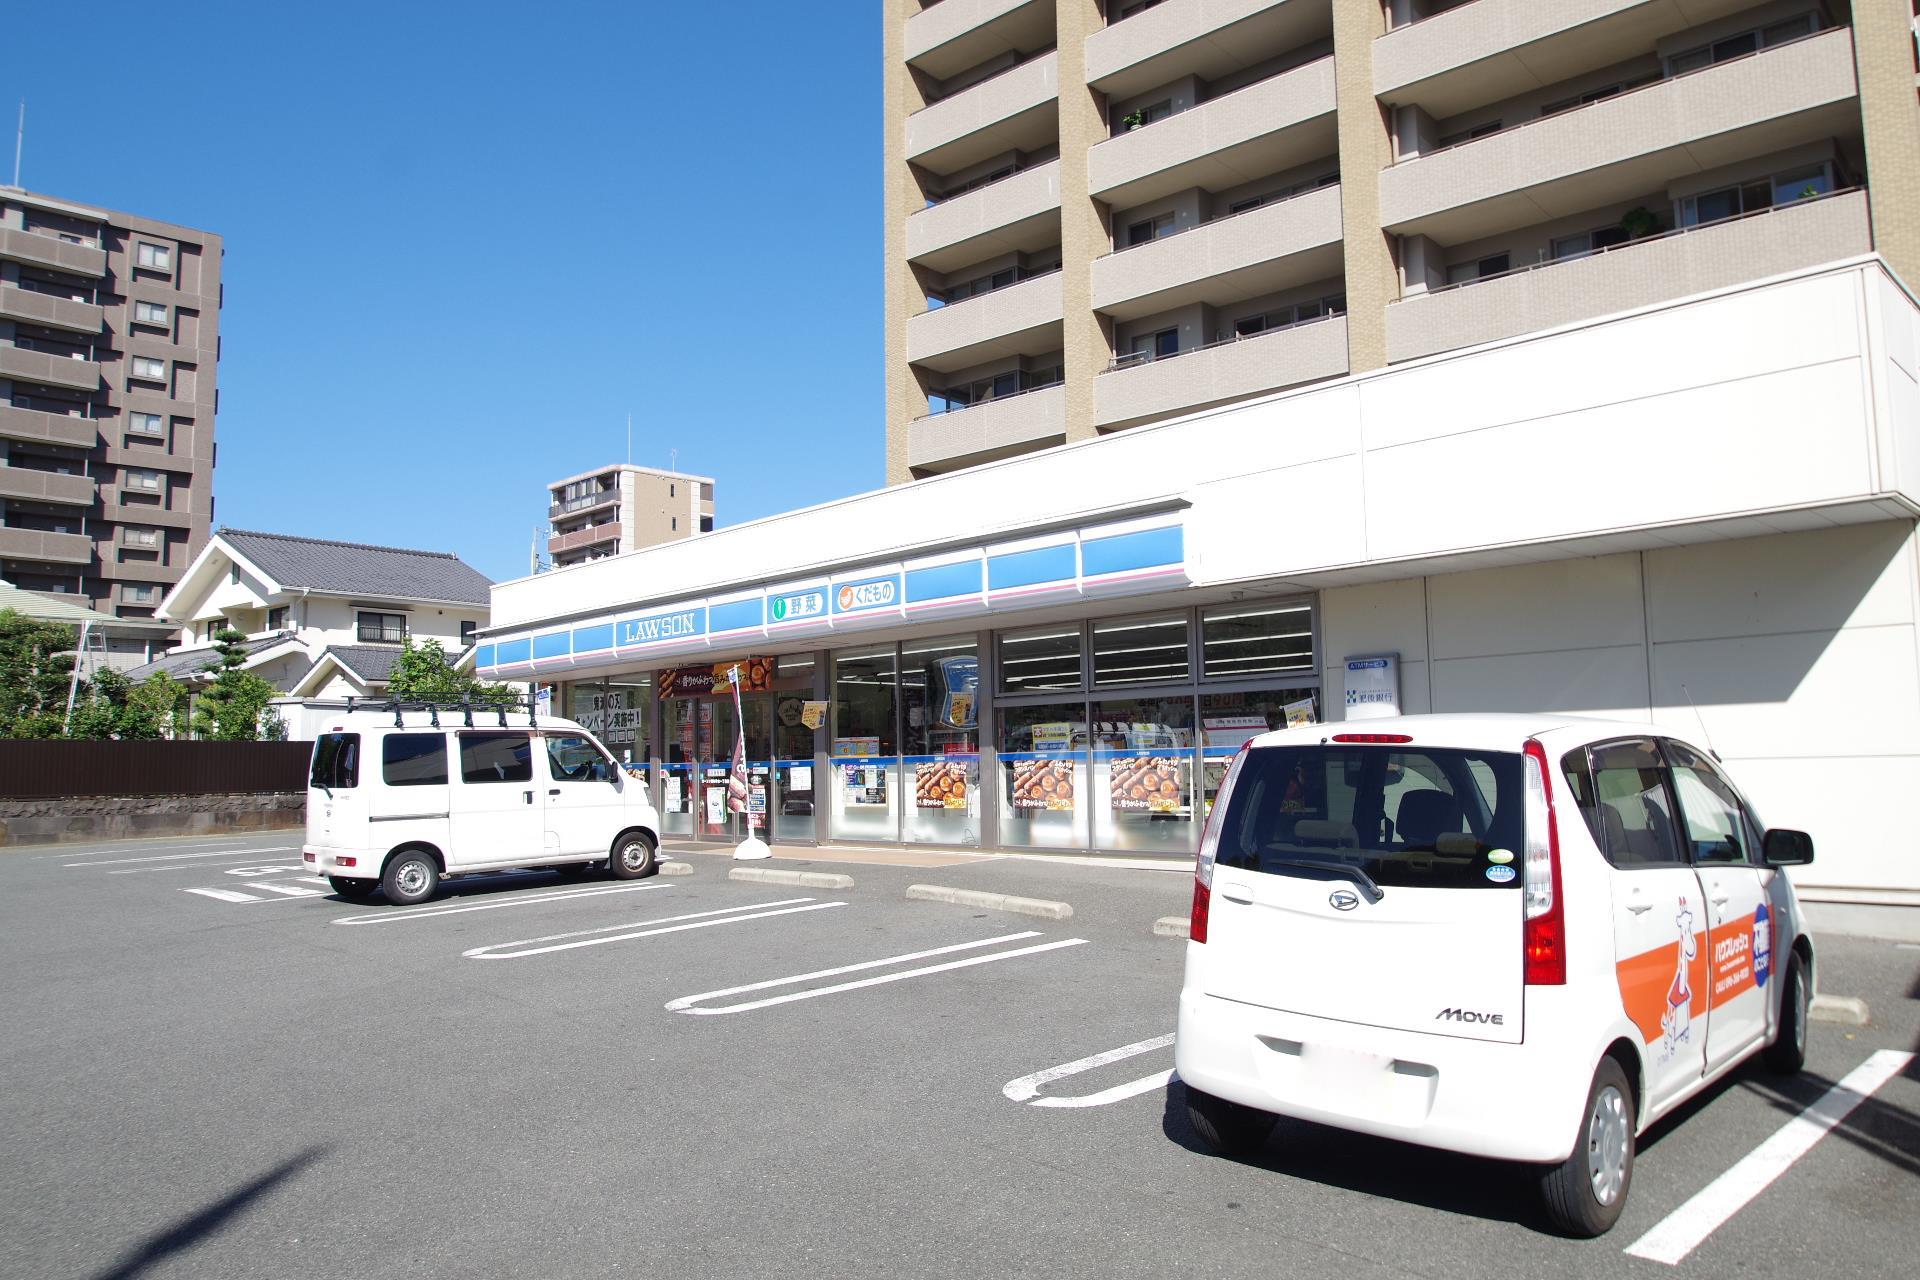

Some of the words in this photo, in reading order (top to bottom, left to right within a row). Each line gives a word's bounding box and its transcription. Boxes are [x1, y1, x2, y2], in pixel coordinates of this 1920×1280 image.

[855, 582, 893, 605] くだもの
[789, 594, 817, 616] 野菜
[624, 612, 696, 643] LAWSON
[1350, 660, 1386, 670] ATMサービス
[1358, 692, 1393, 704] 肥後銀行
[1435, 1007, 1504, 1026] MOVE
